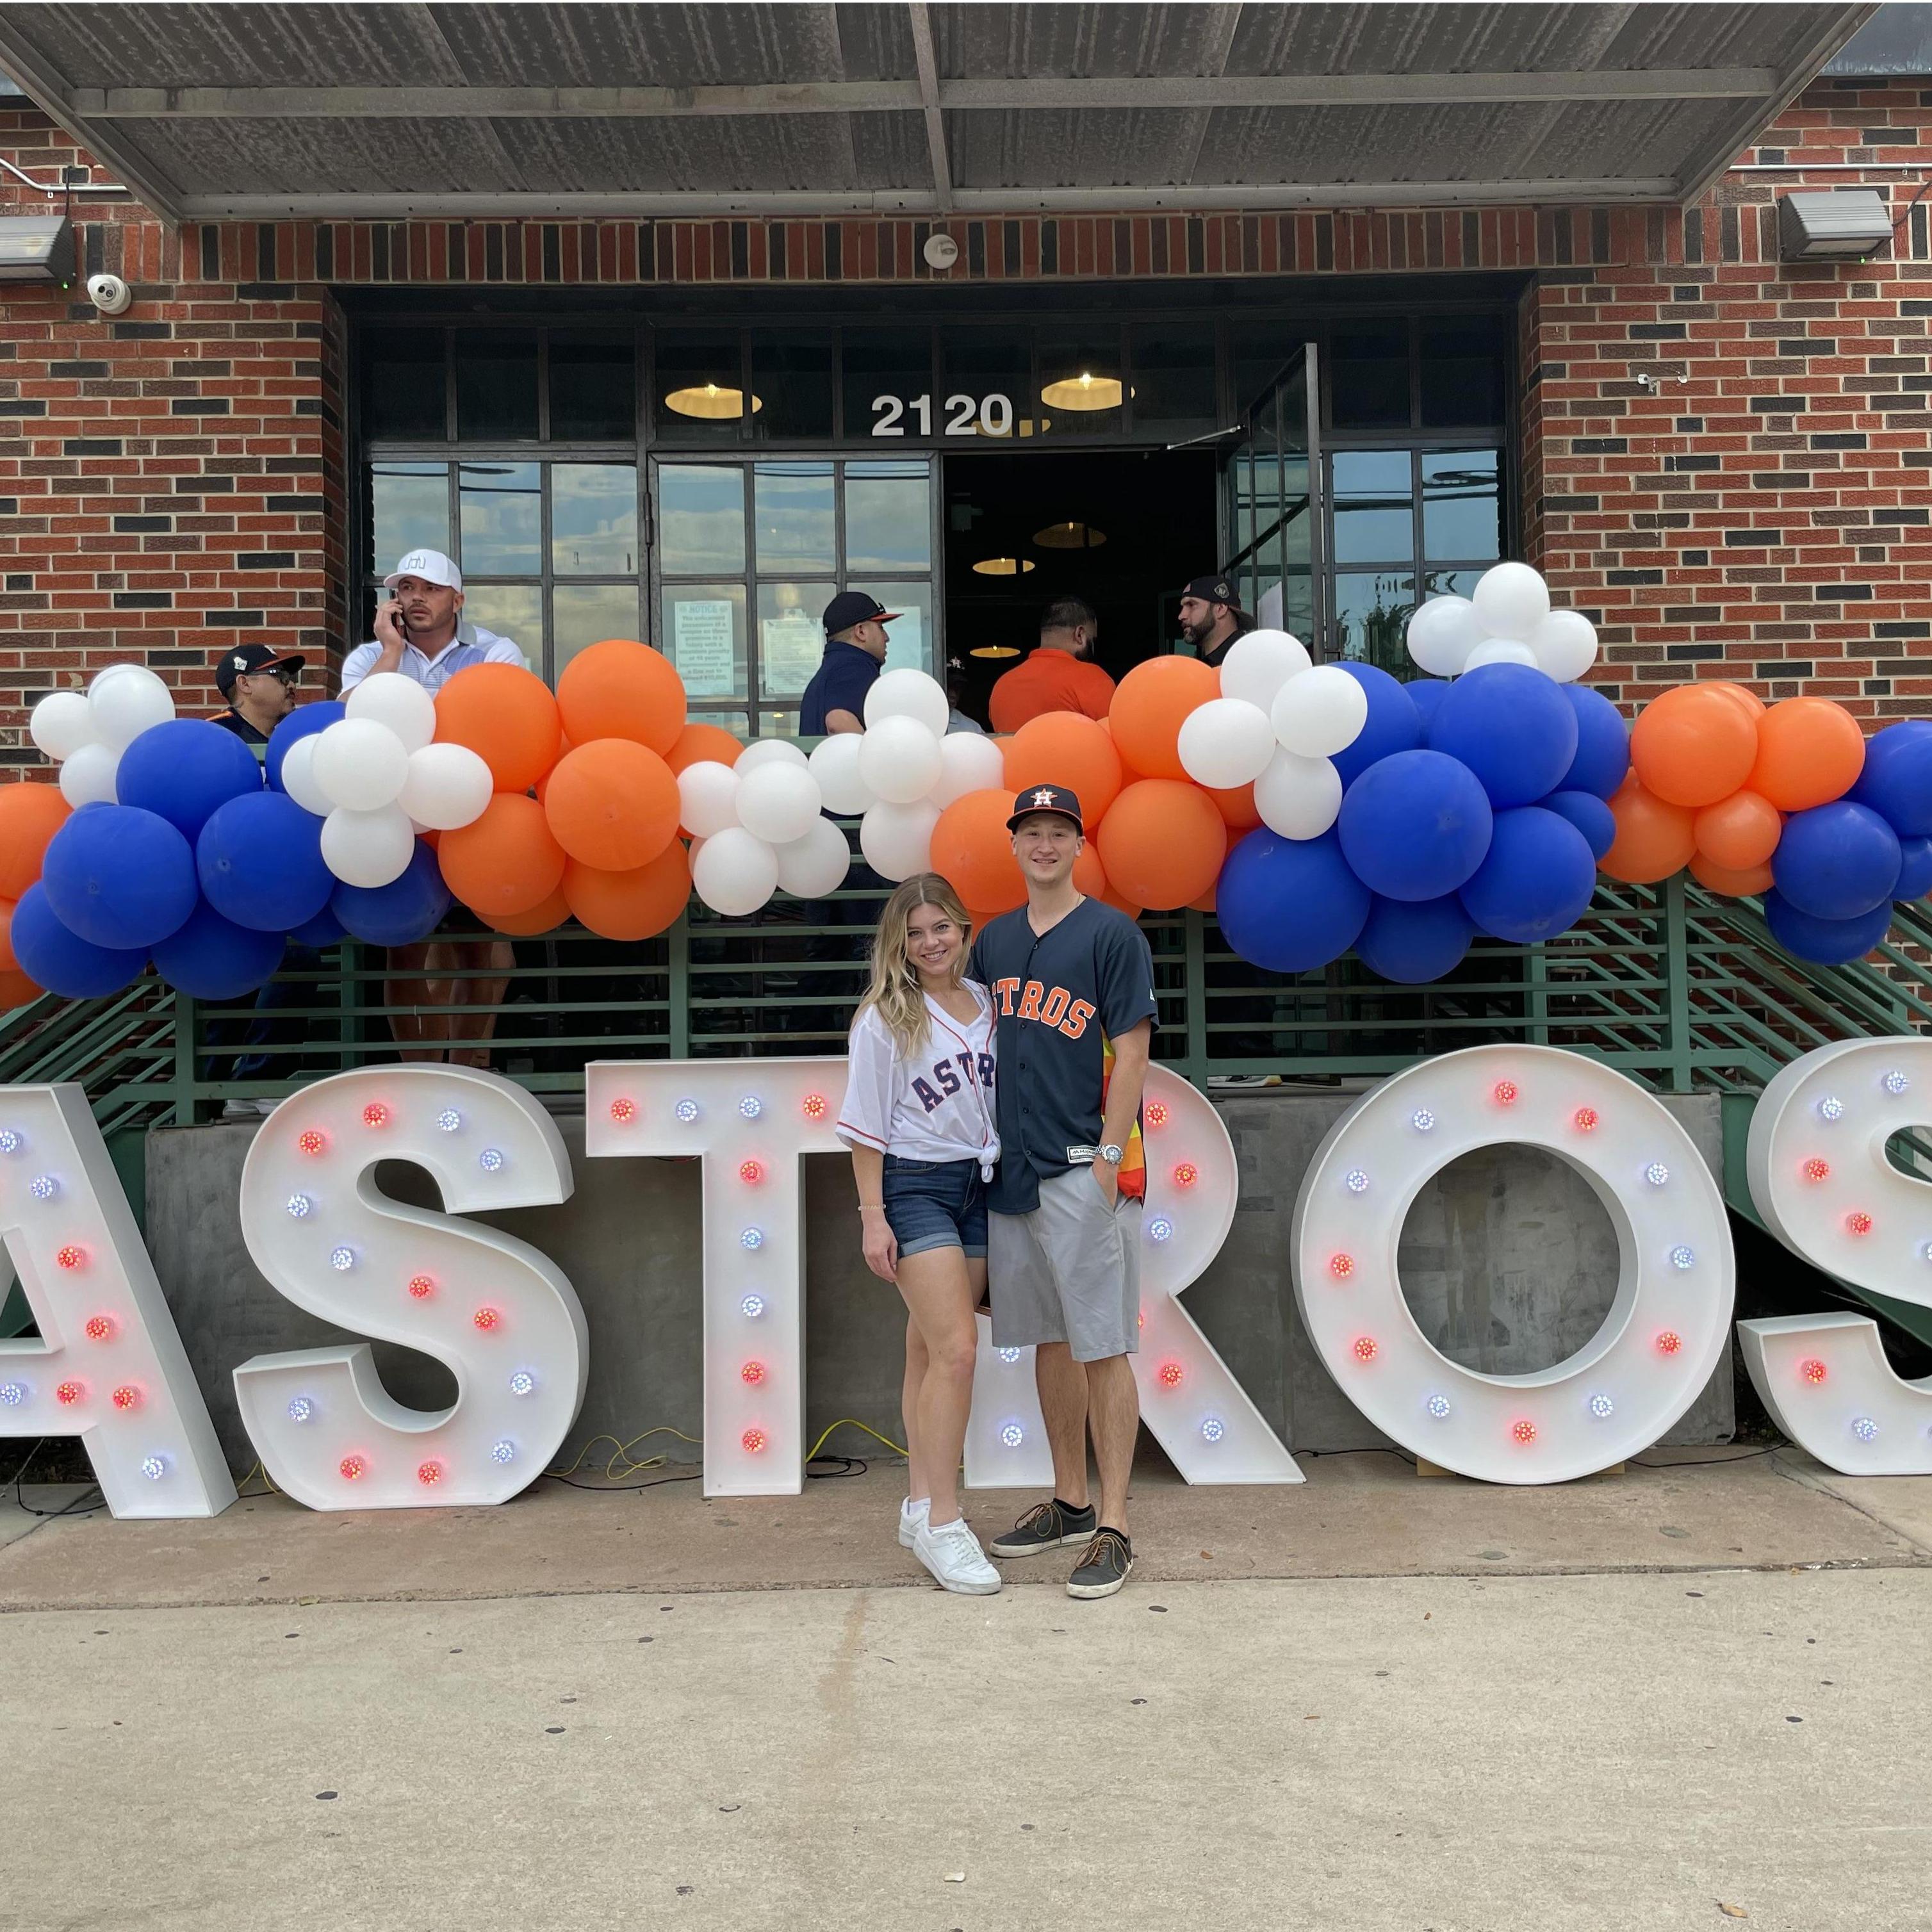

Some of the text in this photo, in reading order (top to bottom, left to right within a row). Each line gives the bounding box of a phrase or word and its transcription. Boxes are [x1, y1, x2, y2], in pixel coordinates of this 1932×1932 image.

[871, 394, 1013, 436] 2120
[1034, 792, 1053, 805] H
[992, 978, 1097, 1040] TROS
